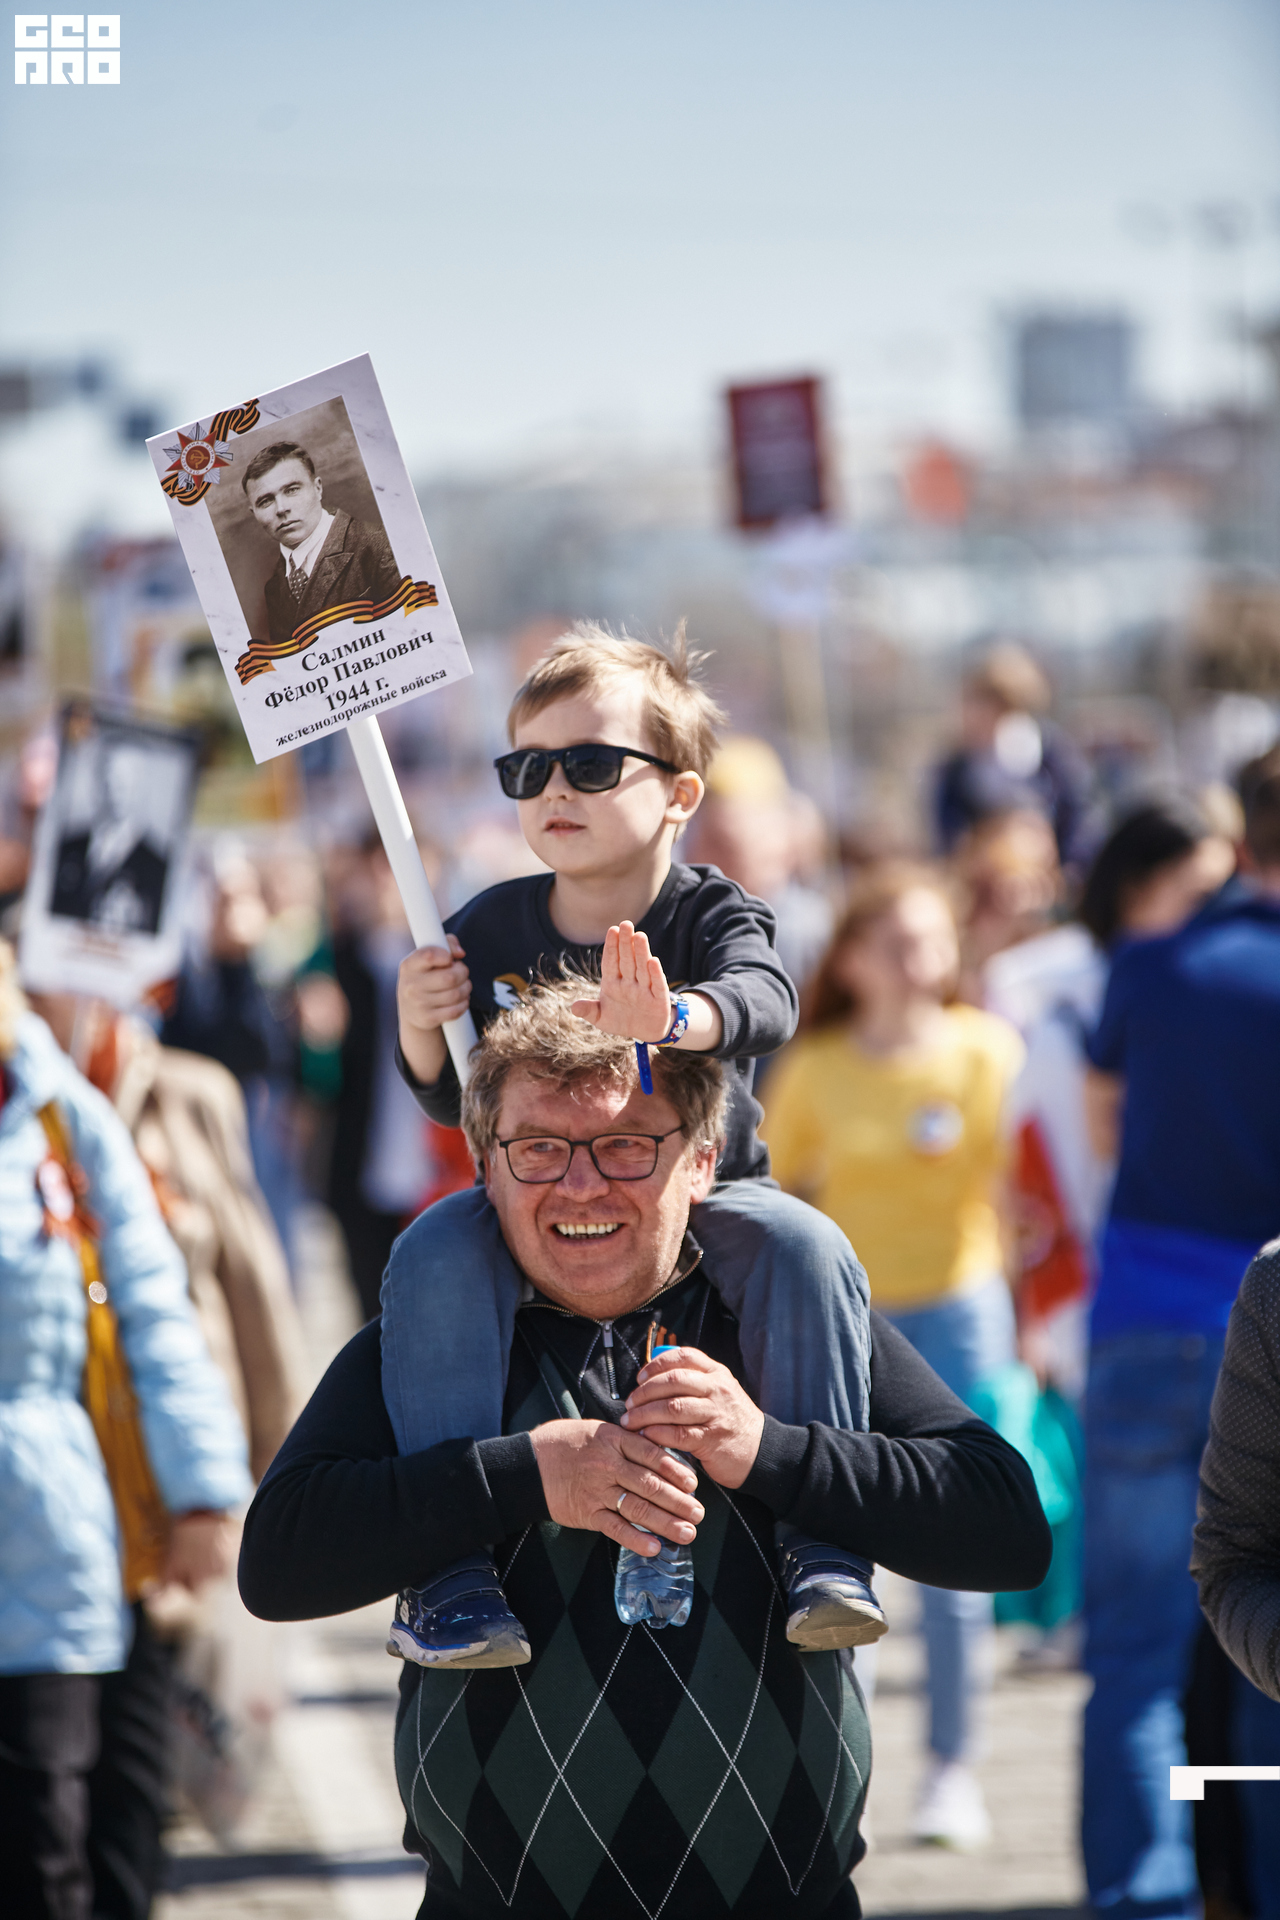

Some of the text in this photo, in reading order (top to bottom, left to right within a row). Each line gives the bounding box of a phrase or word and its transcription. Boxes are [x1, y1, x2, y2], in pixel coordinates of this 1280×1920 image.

[265, 631, 434, 709] Фёдор Павлович
[301, 629, 386, 672] Салмин
[276, 668, 447, 746] железнодорожные войска
[326, 677, 389, 711] 1944 г.
